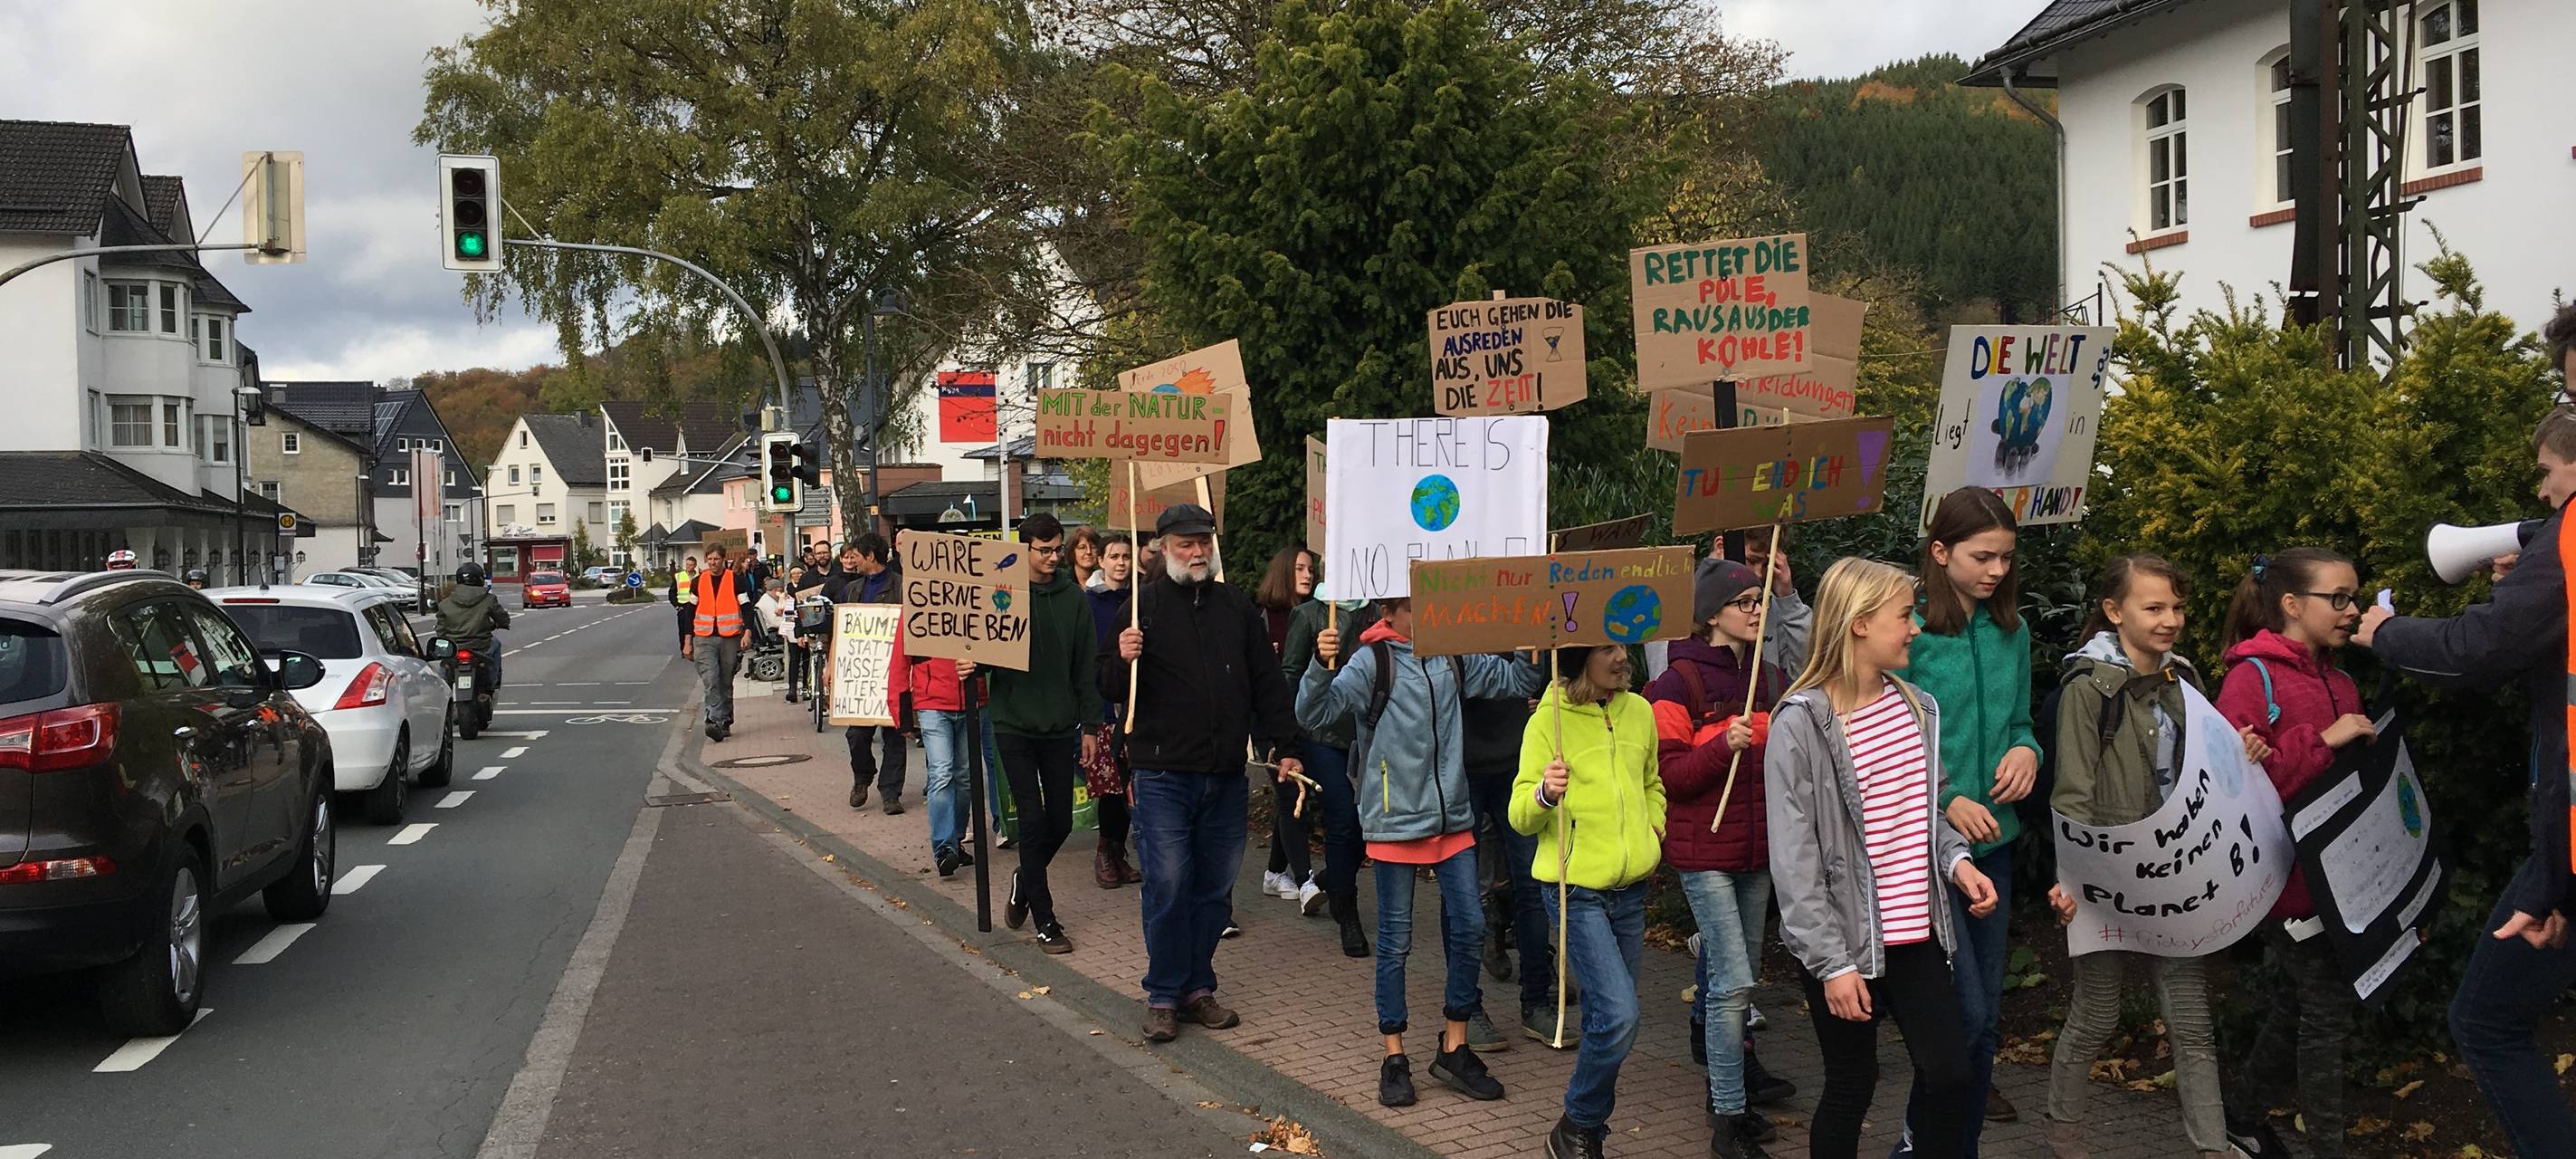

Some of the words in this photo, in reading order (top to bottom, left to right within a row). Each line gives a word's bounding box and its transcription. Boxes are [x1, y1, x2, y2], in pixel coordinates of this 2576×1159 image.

[1645, 245, 1750, 285] RETTET
[1436, 308, 1481, 331] EUCH
[1487, 303, 1540, 326] GEHEN
[1545, 301, 1573, 321] DIE
[1443, 327, 1522, 358] AUSREDEN
[1697, 330, 1803, 368] KOHLE!
[1970, 336, 2016, 379] DIE
[2025, 333, 2086, 375] WELT
[1435, 356, 1480, 382] AUS,
[1484, 348, 1523, 378] UNS
[1042, 392, 1086, 416] MIT
[1091, 393, 1121, 417] der
[1445, 384, 1477, 410] DIE
[1044, 419, 1096, 447] nicht
[1105, 419, 1226, 457] dagegen!
[1935, 398, 1971, 449] liegt
[2069, 411, 2085, 436] in
[1359, 417, 1469, 467] THERE
[1484, 418, 1510, 470] IS
[1684, 465, 1739, 497] TUT
[1752, 492, 1808, 519] WAS
[2030, 486, 2083, 520] HAND!
[911, 539, 984, 577] WÄRE
[1350, 543, 1389, 599] NO
[1496, 569, 1532, 587] nur
[1620, 554, 1692, 579] endlich
[908, 580, 982, 609] GERNE
[844, 612, 899, 637] BÄUME
[848, 637, 893, 657] STATT
[835, 696, 892, 717] HALTUN
[2061, 821, 2135, 854] Wir
[2154, 768, 2210, 848] haben
